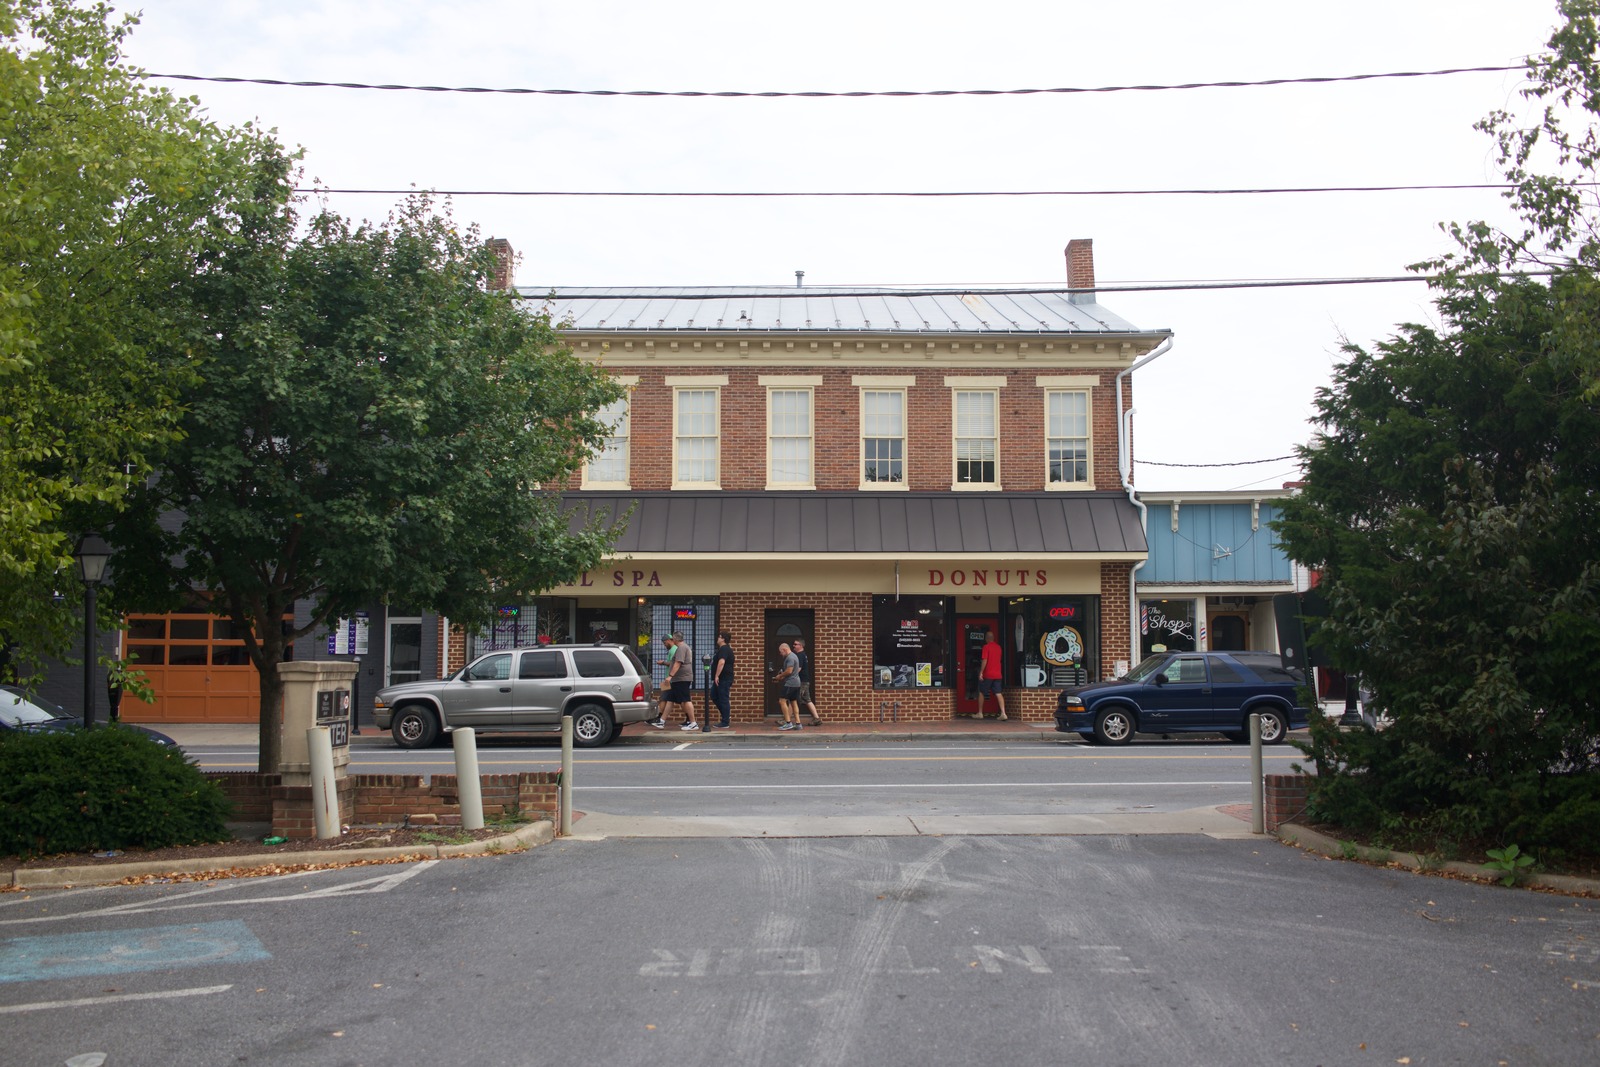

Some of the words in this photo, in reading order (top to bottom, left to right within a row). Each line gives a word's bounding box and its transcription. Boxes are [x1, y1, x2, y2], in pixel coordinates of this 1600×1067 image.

[613, 570, 662, 587] SPA
[928, 569, 1047, 586] DONUTS
[1050, 607, 1075, 617] OPEN
[1149, 615, 1184, 631] Shop
